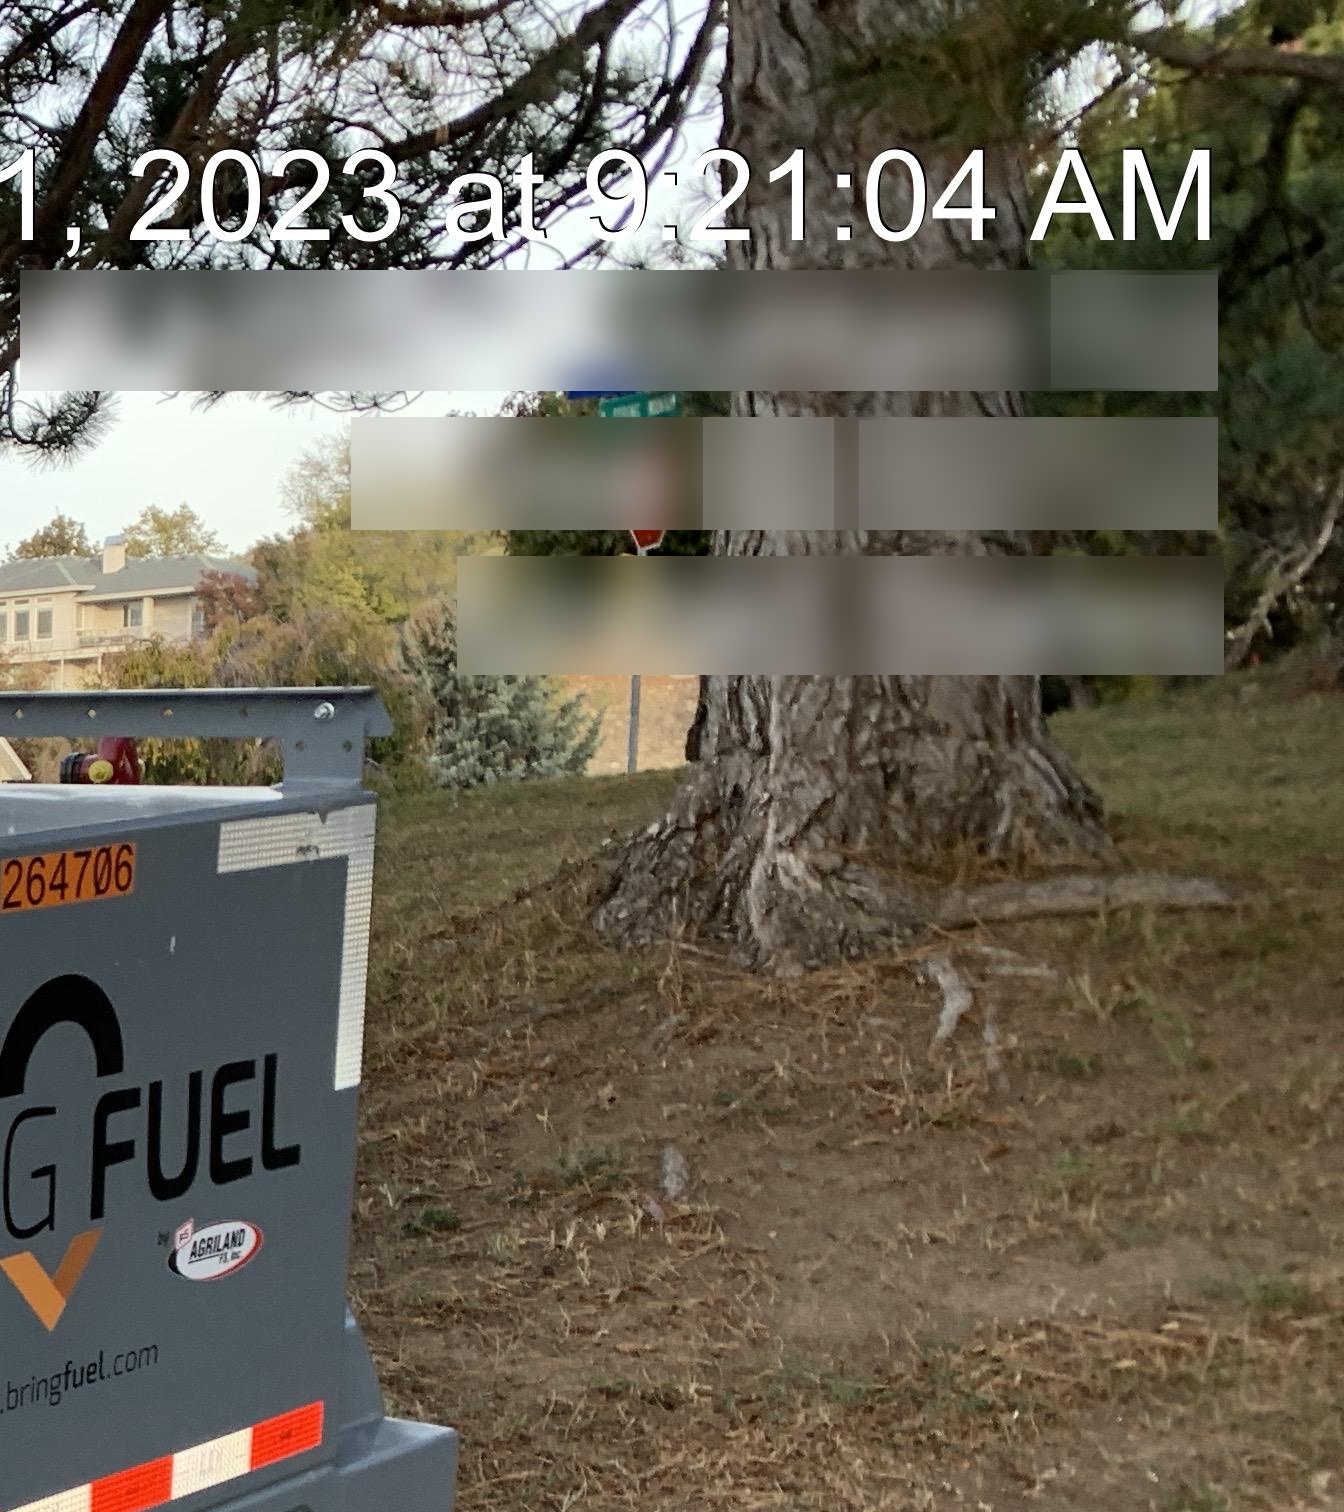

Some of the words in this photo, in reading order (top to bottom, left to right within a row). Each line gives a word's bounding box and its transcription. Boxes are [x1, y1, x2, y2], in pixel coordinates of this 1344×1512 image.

[2, 843, 135, 910] 264706
[90, 1053, 301, 1221] FUEL
[189, 1228, 246, 1259] AGRILAND
